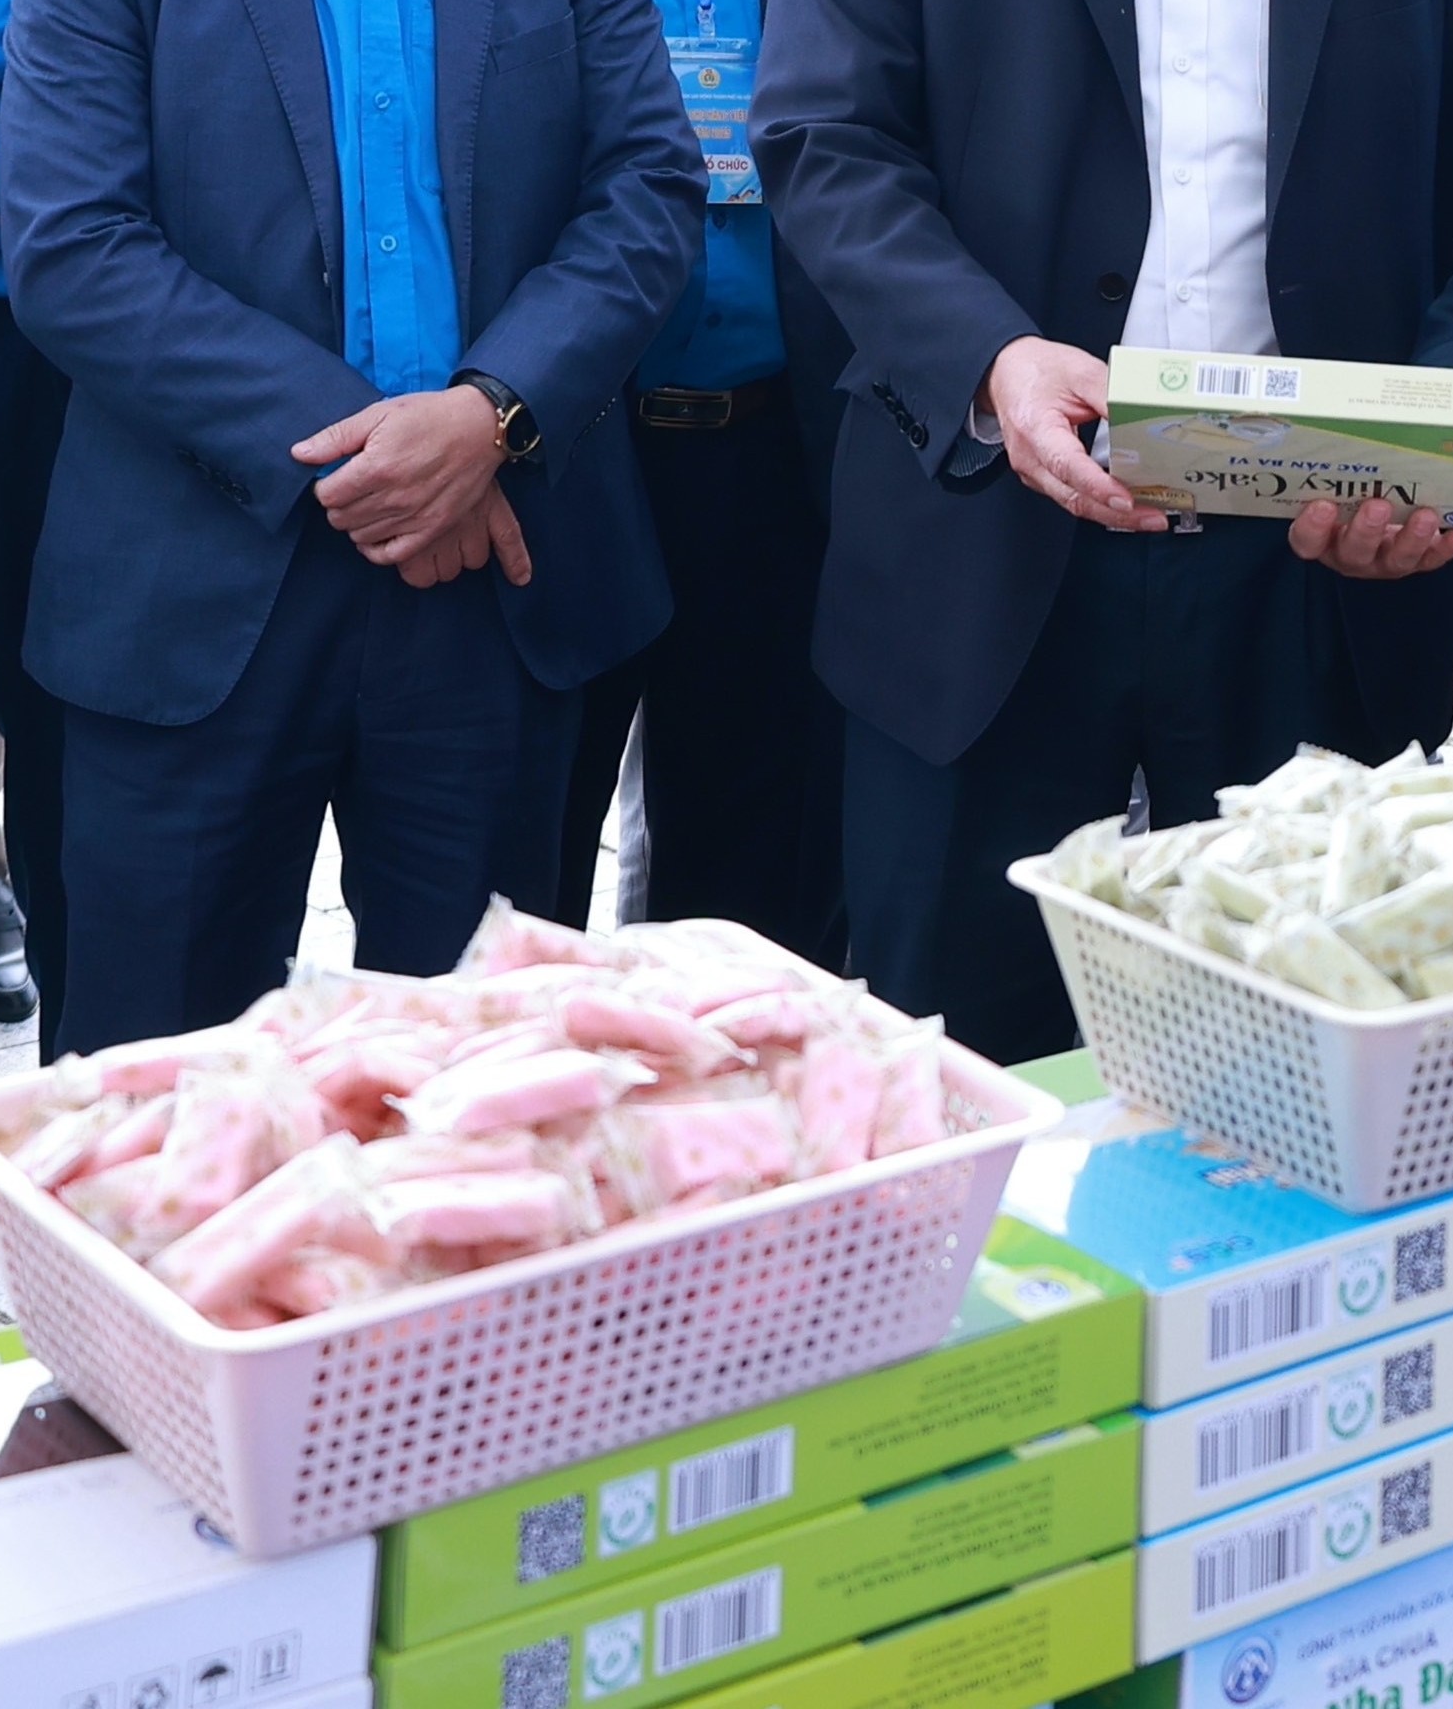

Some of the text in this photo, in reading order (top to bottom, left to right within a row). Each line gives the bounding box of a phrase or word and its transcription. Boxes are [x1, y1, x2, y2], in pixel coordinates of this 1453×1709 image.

[718, 157, 749, 172] CHỨC
[1256, 457, 1285, 469] BA
[1183, 468, 1286, 499] Cake
[1299, 473, 1419, 506] Milky
[1374, 1627, 1439, 1670] CHUA
